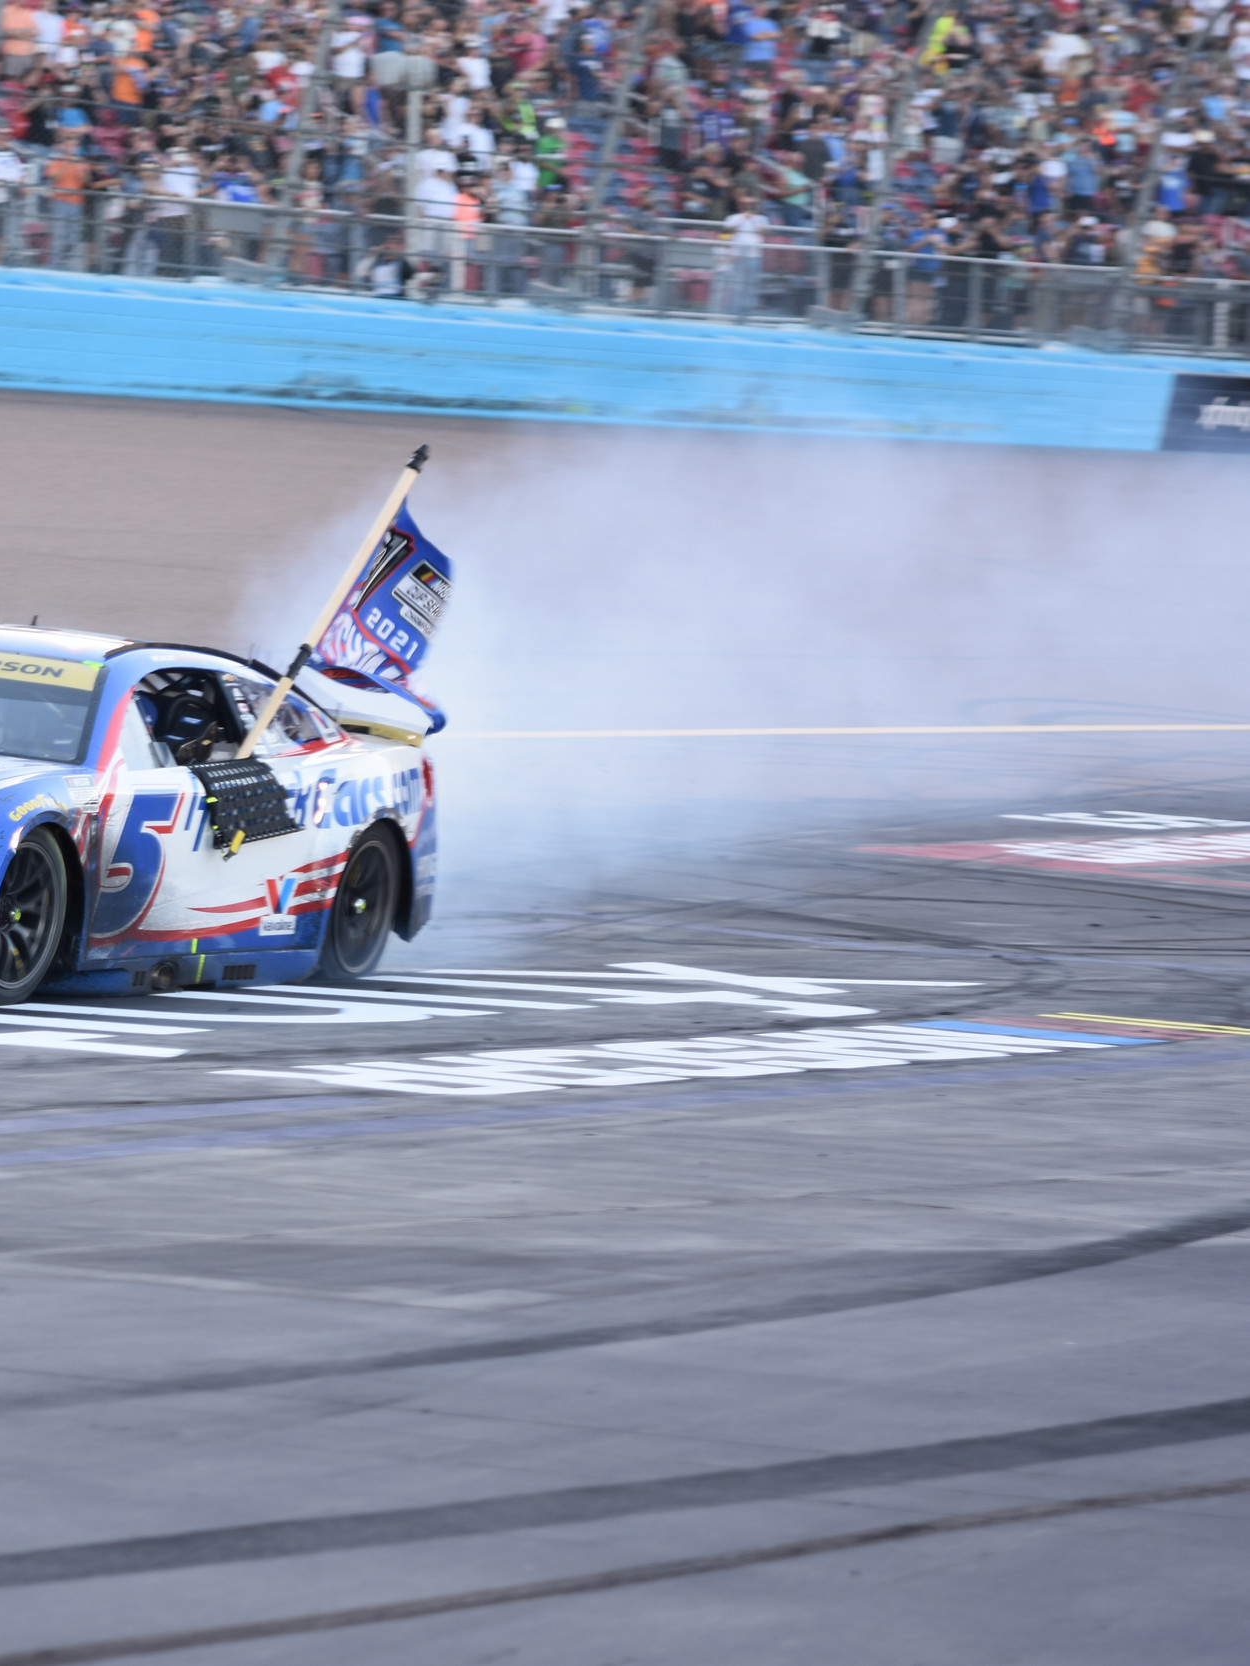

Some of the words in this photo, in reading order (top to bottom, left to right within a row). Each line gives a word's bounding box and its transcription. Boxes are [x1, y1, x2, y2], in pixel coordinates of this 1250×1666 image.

[365, 607, 419, 660] 2021
[9, 794, 69, 821] GOOD
[88, 783, 186, 939] 5
[208, 1025, 1118, 1096] NASCAR
